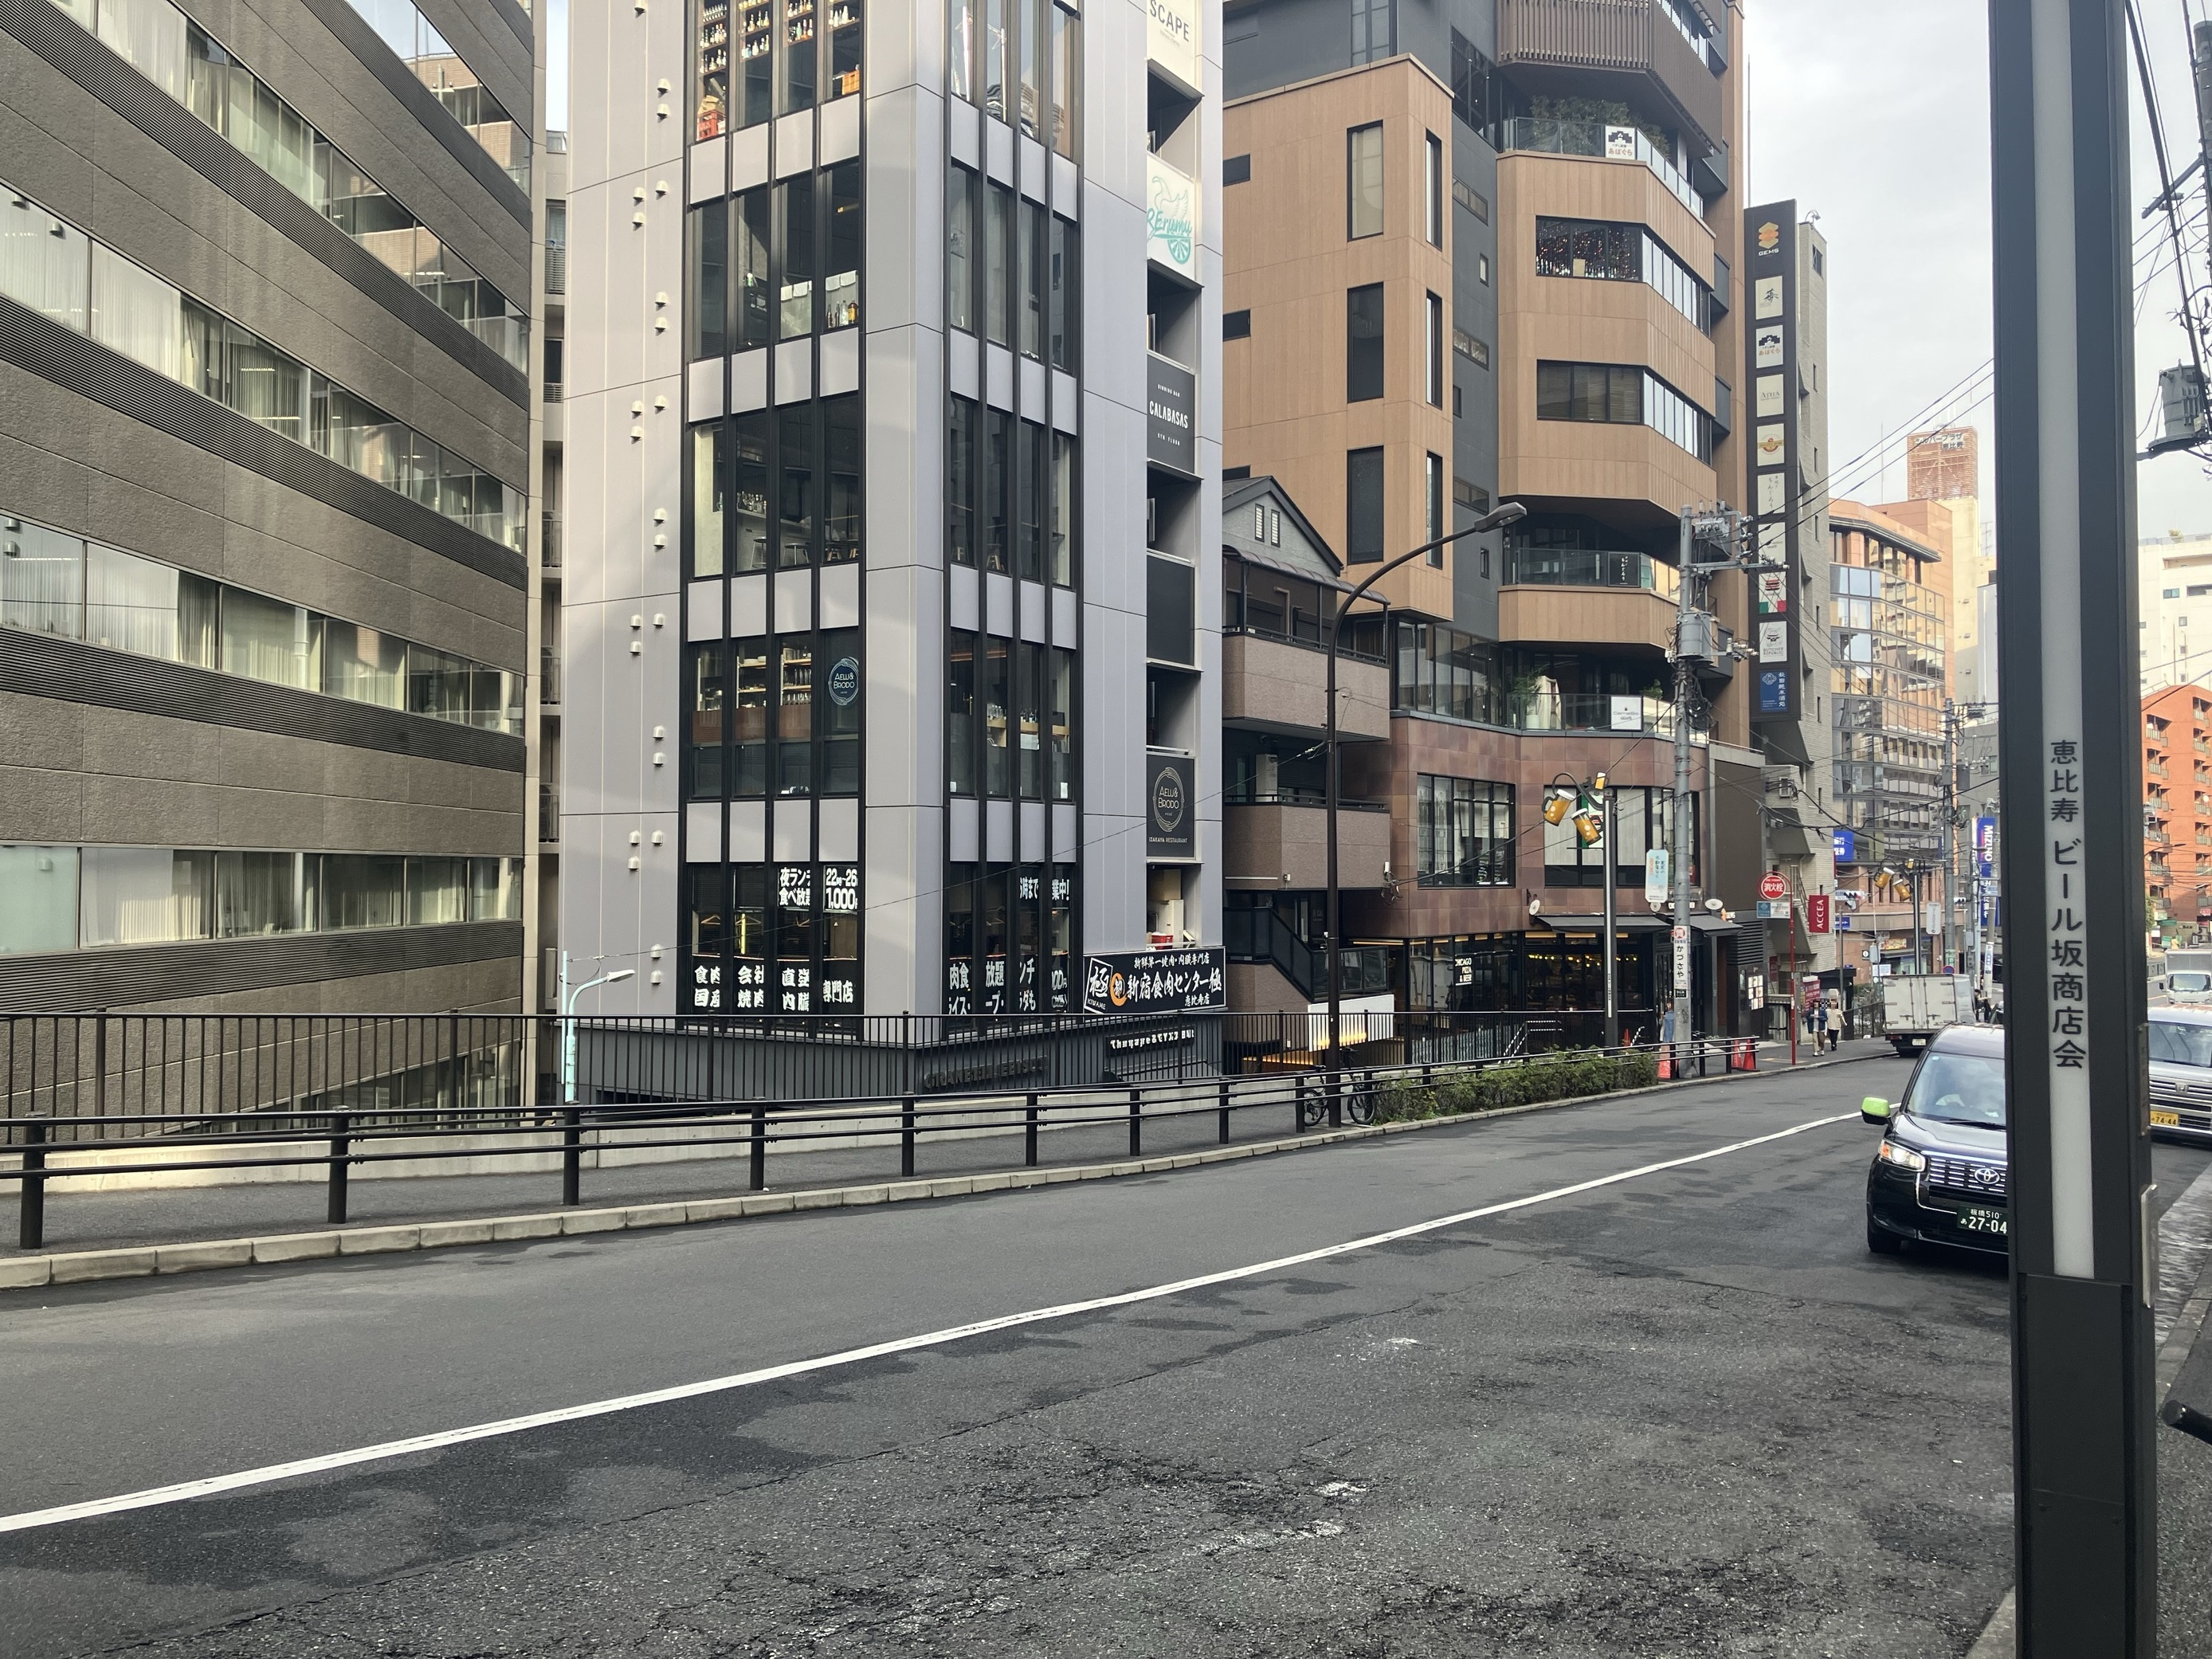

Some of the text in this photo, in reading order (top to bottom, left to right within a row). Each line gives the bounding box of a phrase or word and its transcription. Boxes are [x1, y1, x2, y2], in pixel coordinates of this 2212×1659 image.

[1758, 248, 1779, 257] GEMS
[1149, 400, 1189, 429] CALABASAS
[1158, 797, 1179, 810] BRODO
[1763, 882, 1784, 892] 消火栓
[2050, 838, 2087, 1069] ビール坂商店会
[1089, 966, 1110, 998] 極
[1087, 998, 1107, 1010] KIWAME
[1184, 993, 1210, 1007] 恵比寿店
[1986, 1210, 2000, 1219] 510
[1968, 1216, 2007, 1234] 27-04
